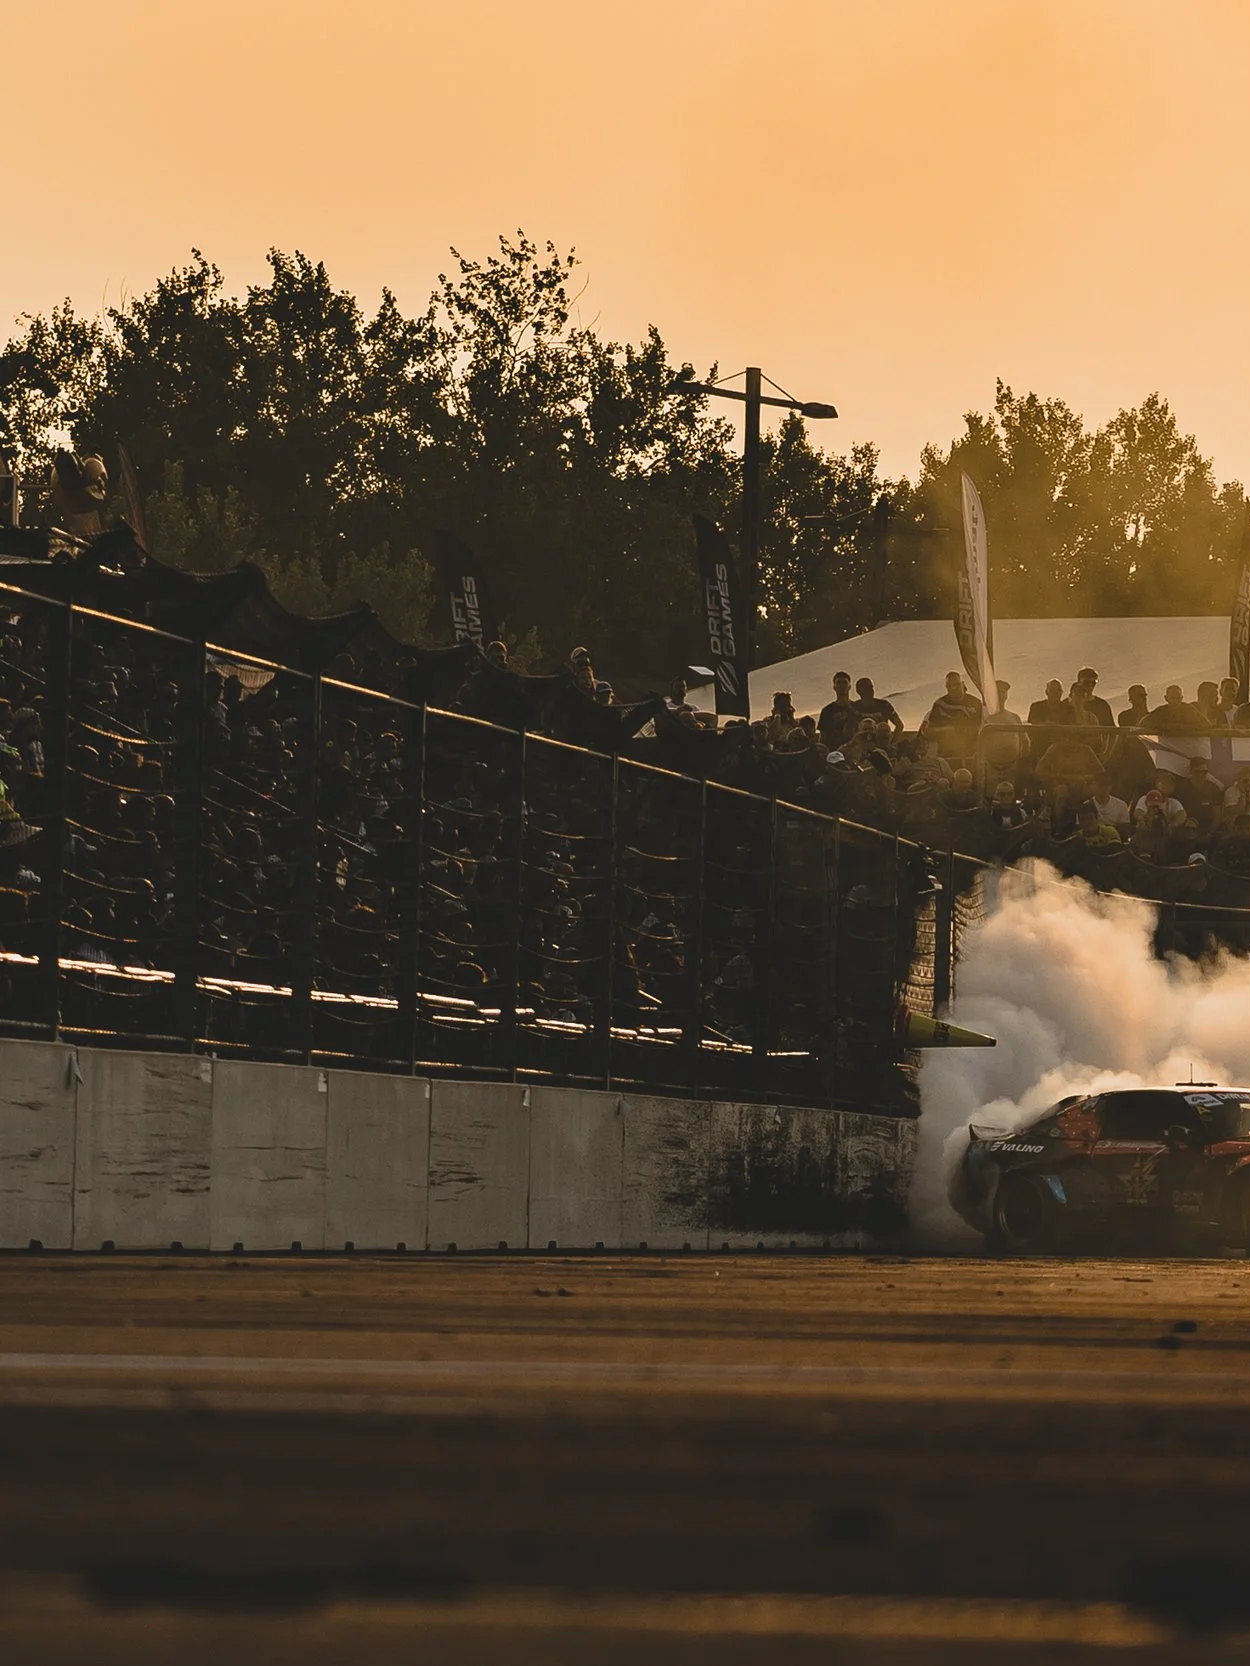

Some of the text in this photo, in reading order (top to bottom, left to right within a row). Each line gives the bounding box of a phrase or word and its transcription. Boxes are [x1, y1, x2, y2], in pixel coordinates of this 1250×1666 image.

[449, 591, 470, 643] RIFT
[461, 575, 485, 652] AMES
[705, 577, 723, 655] DRIFT
[715, 563, 736, 657] GAMES
[957, 571, 973, 648] DRIFT
[1001, 1143, 1045, 1155] VALINO
